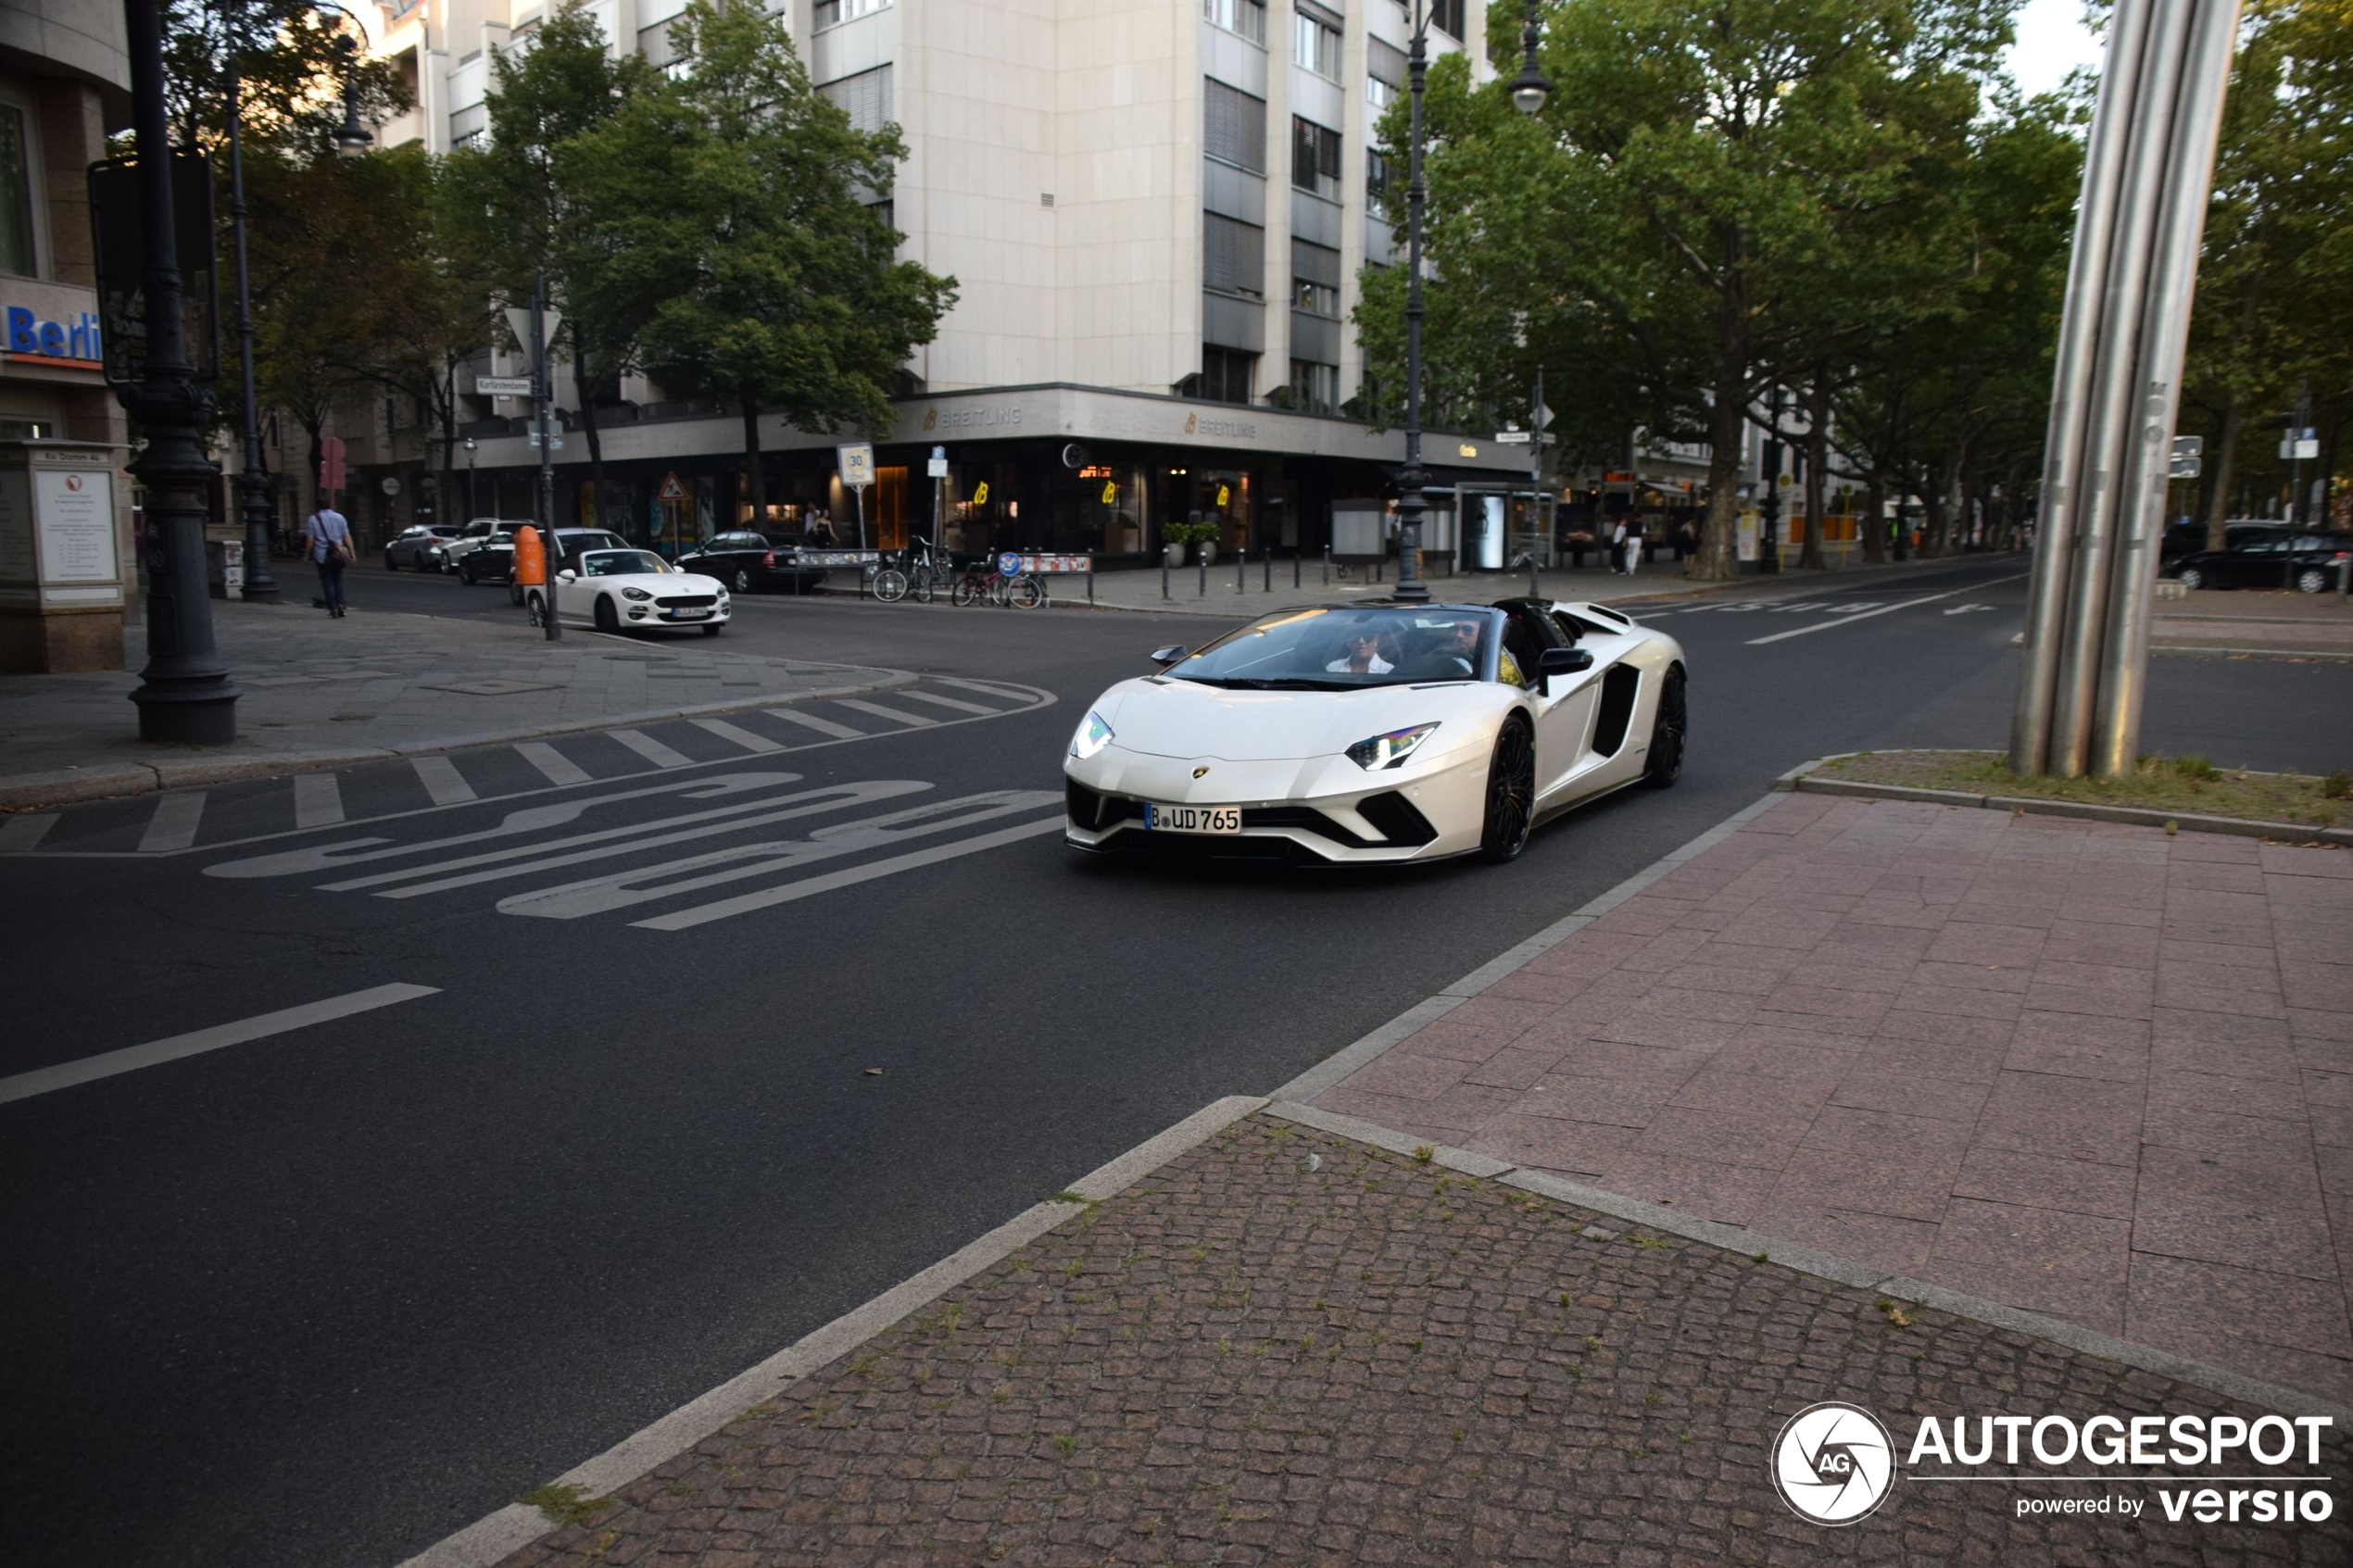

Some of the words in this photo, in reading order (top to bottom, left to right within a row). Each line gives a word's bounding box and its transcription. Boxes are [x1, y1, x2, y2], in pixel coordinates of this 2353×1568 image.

[7, 306, 101, 359] Berli
[479, 380, 528, 390] Kurfürstendamm
[941, 407, 1022, 429] BREITLING
[1199, 419, 1255, 439] BREITLING
[849, 455, 862, 467] 30
[1151, 808, 1160, 827] B
[1172, 809, 1196, 829] UD
[1201, 810, 1239, 830] 765
[201, 771, 1067, 931] BUS
